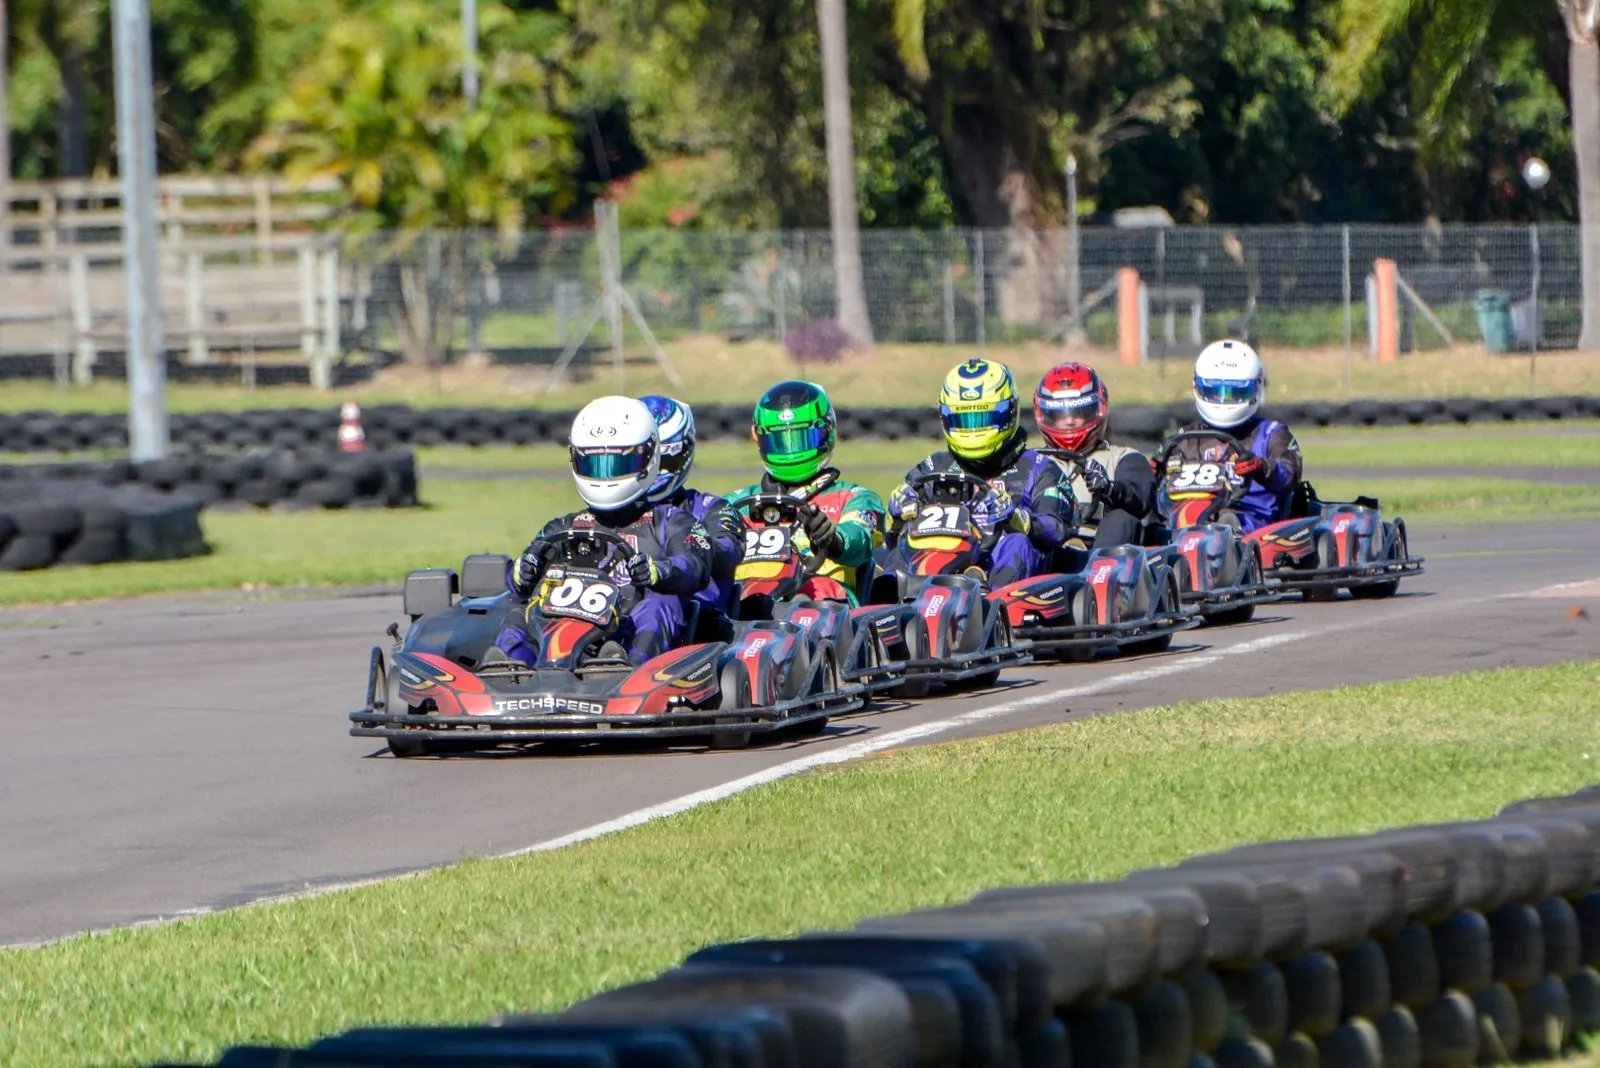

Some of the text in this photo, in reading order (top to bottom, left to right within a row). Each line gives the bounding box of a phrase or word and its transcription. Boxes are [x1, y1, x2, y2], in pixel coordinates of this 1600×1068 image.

[1173, 463, 1220, 486] 38
[918, 506, 960, 530] 21
[745, 528, 785, 557] 29
[550, 578, 614, 613] 06
[495, 697, 603, 715] TECHSPEED
